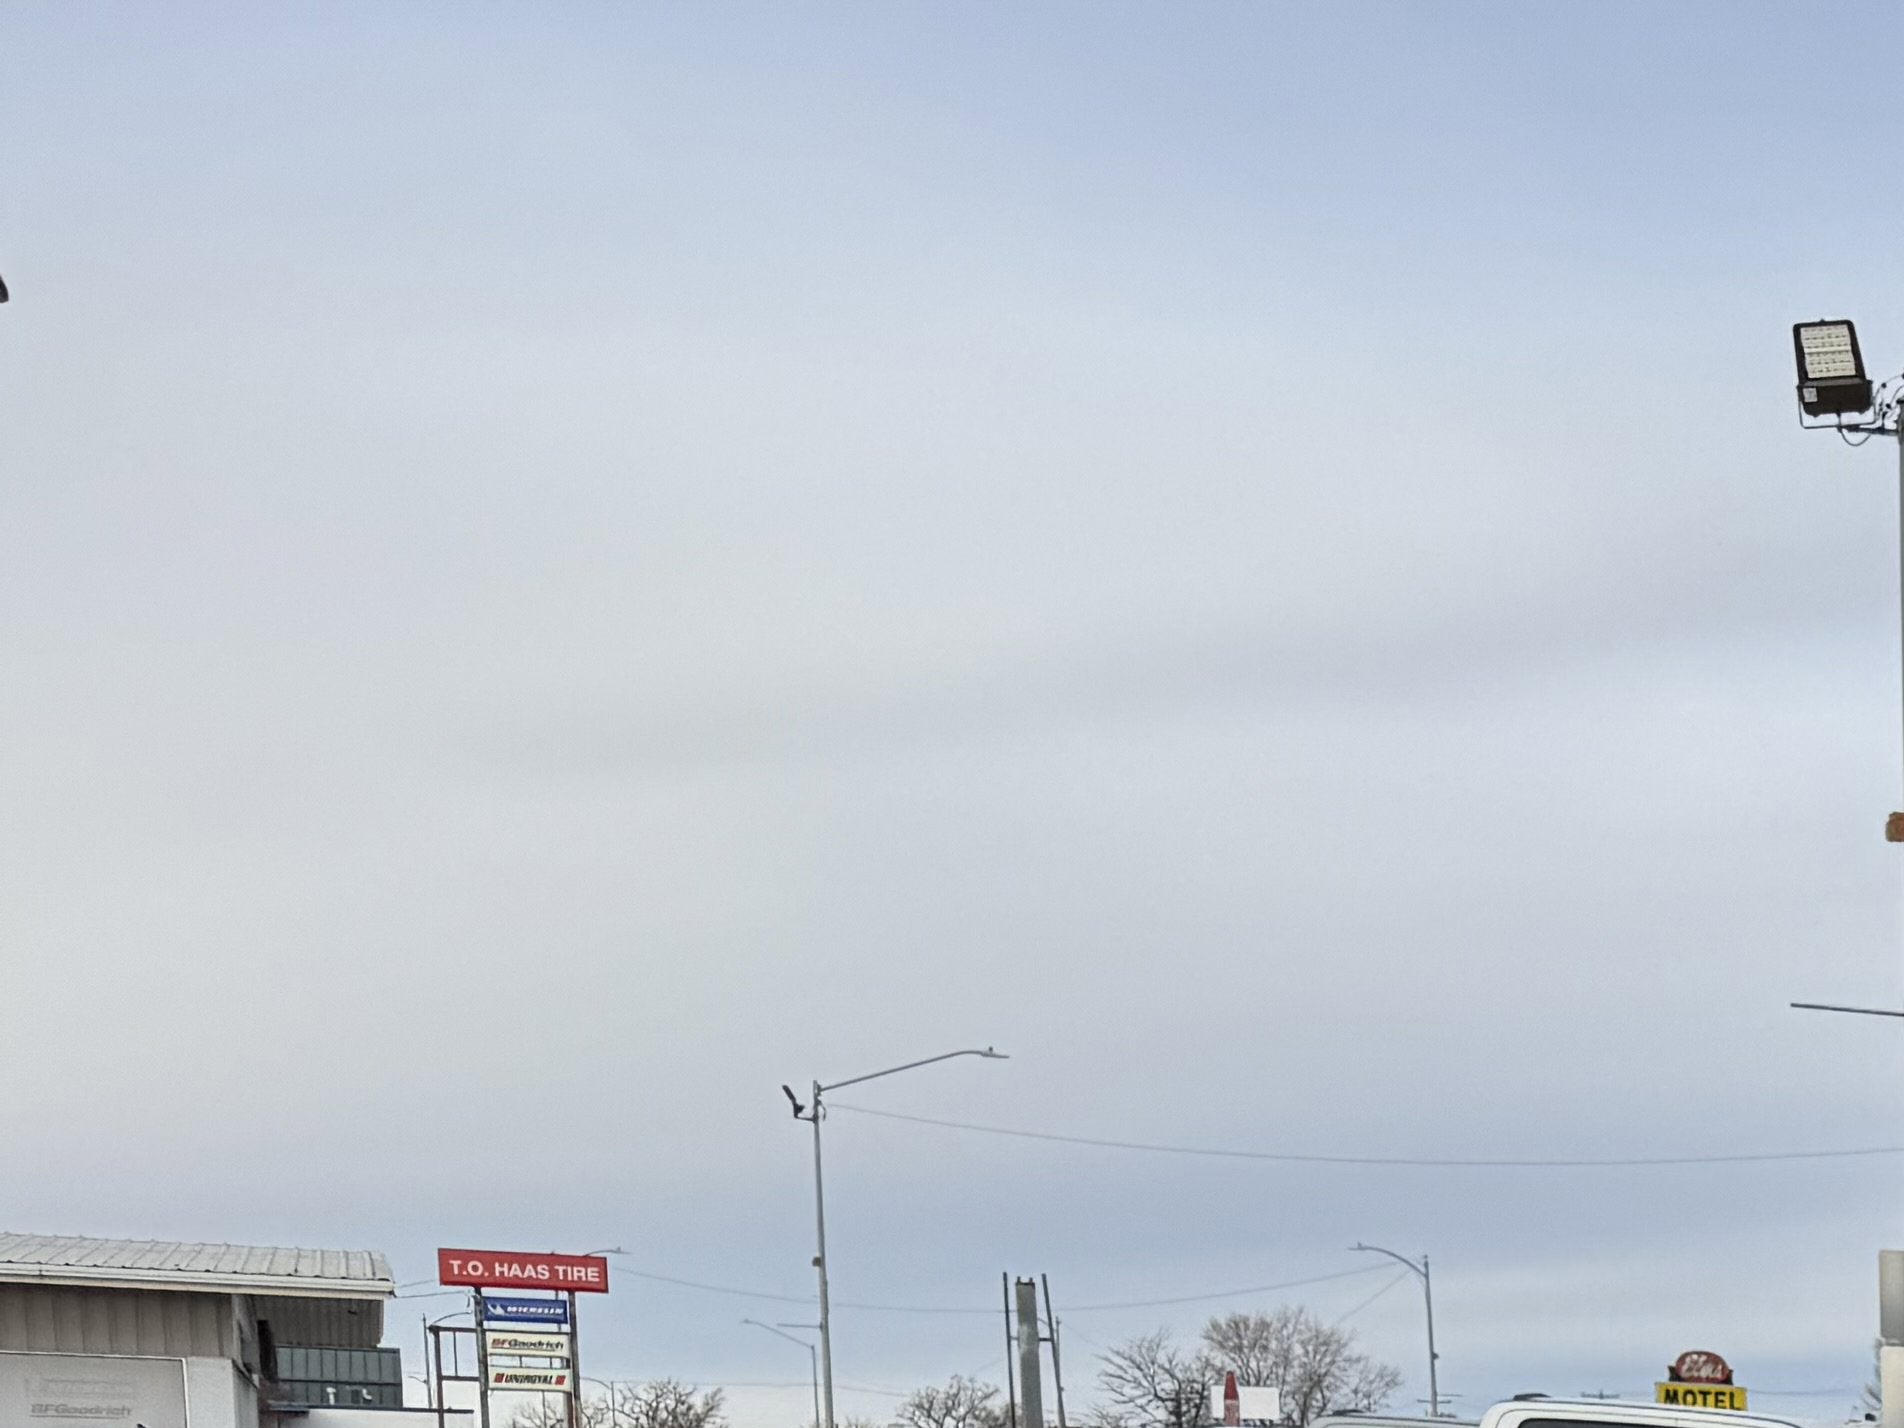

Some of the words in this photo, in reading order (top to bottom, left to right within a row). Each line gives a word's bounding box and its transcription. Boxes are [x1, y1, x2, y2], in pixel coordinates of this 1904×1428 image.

[449, 1260, 489, 1277] T.O.
[494, 1262, 550, 1280] HAAS
[554, 1265, 600, 1283] TIRE
[491, 1338, 564, 1351] BFGoodrich
[504, 1373, 554, 1385] UNIROYAL
[1664, 1389, 1745, 1411] MOTEL
[31, 1403, 132, 1417] BFGoodrich
